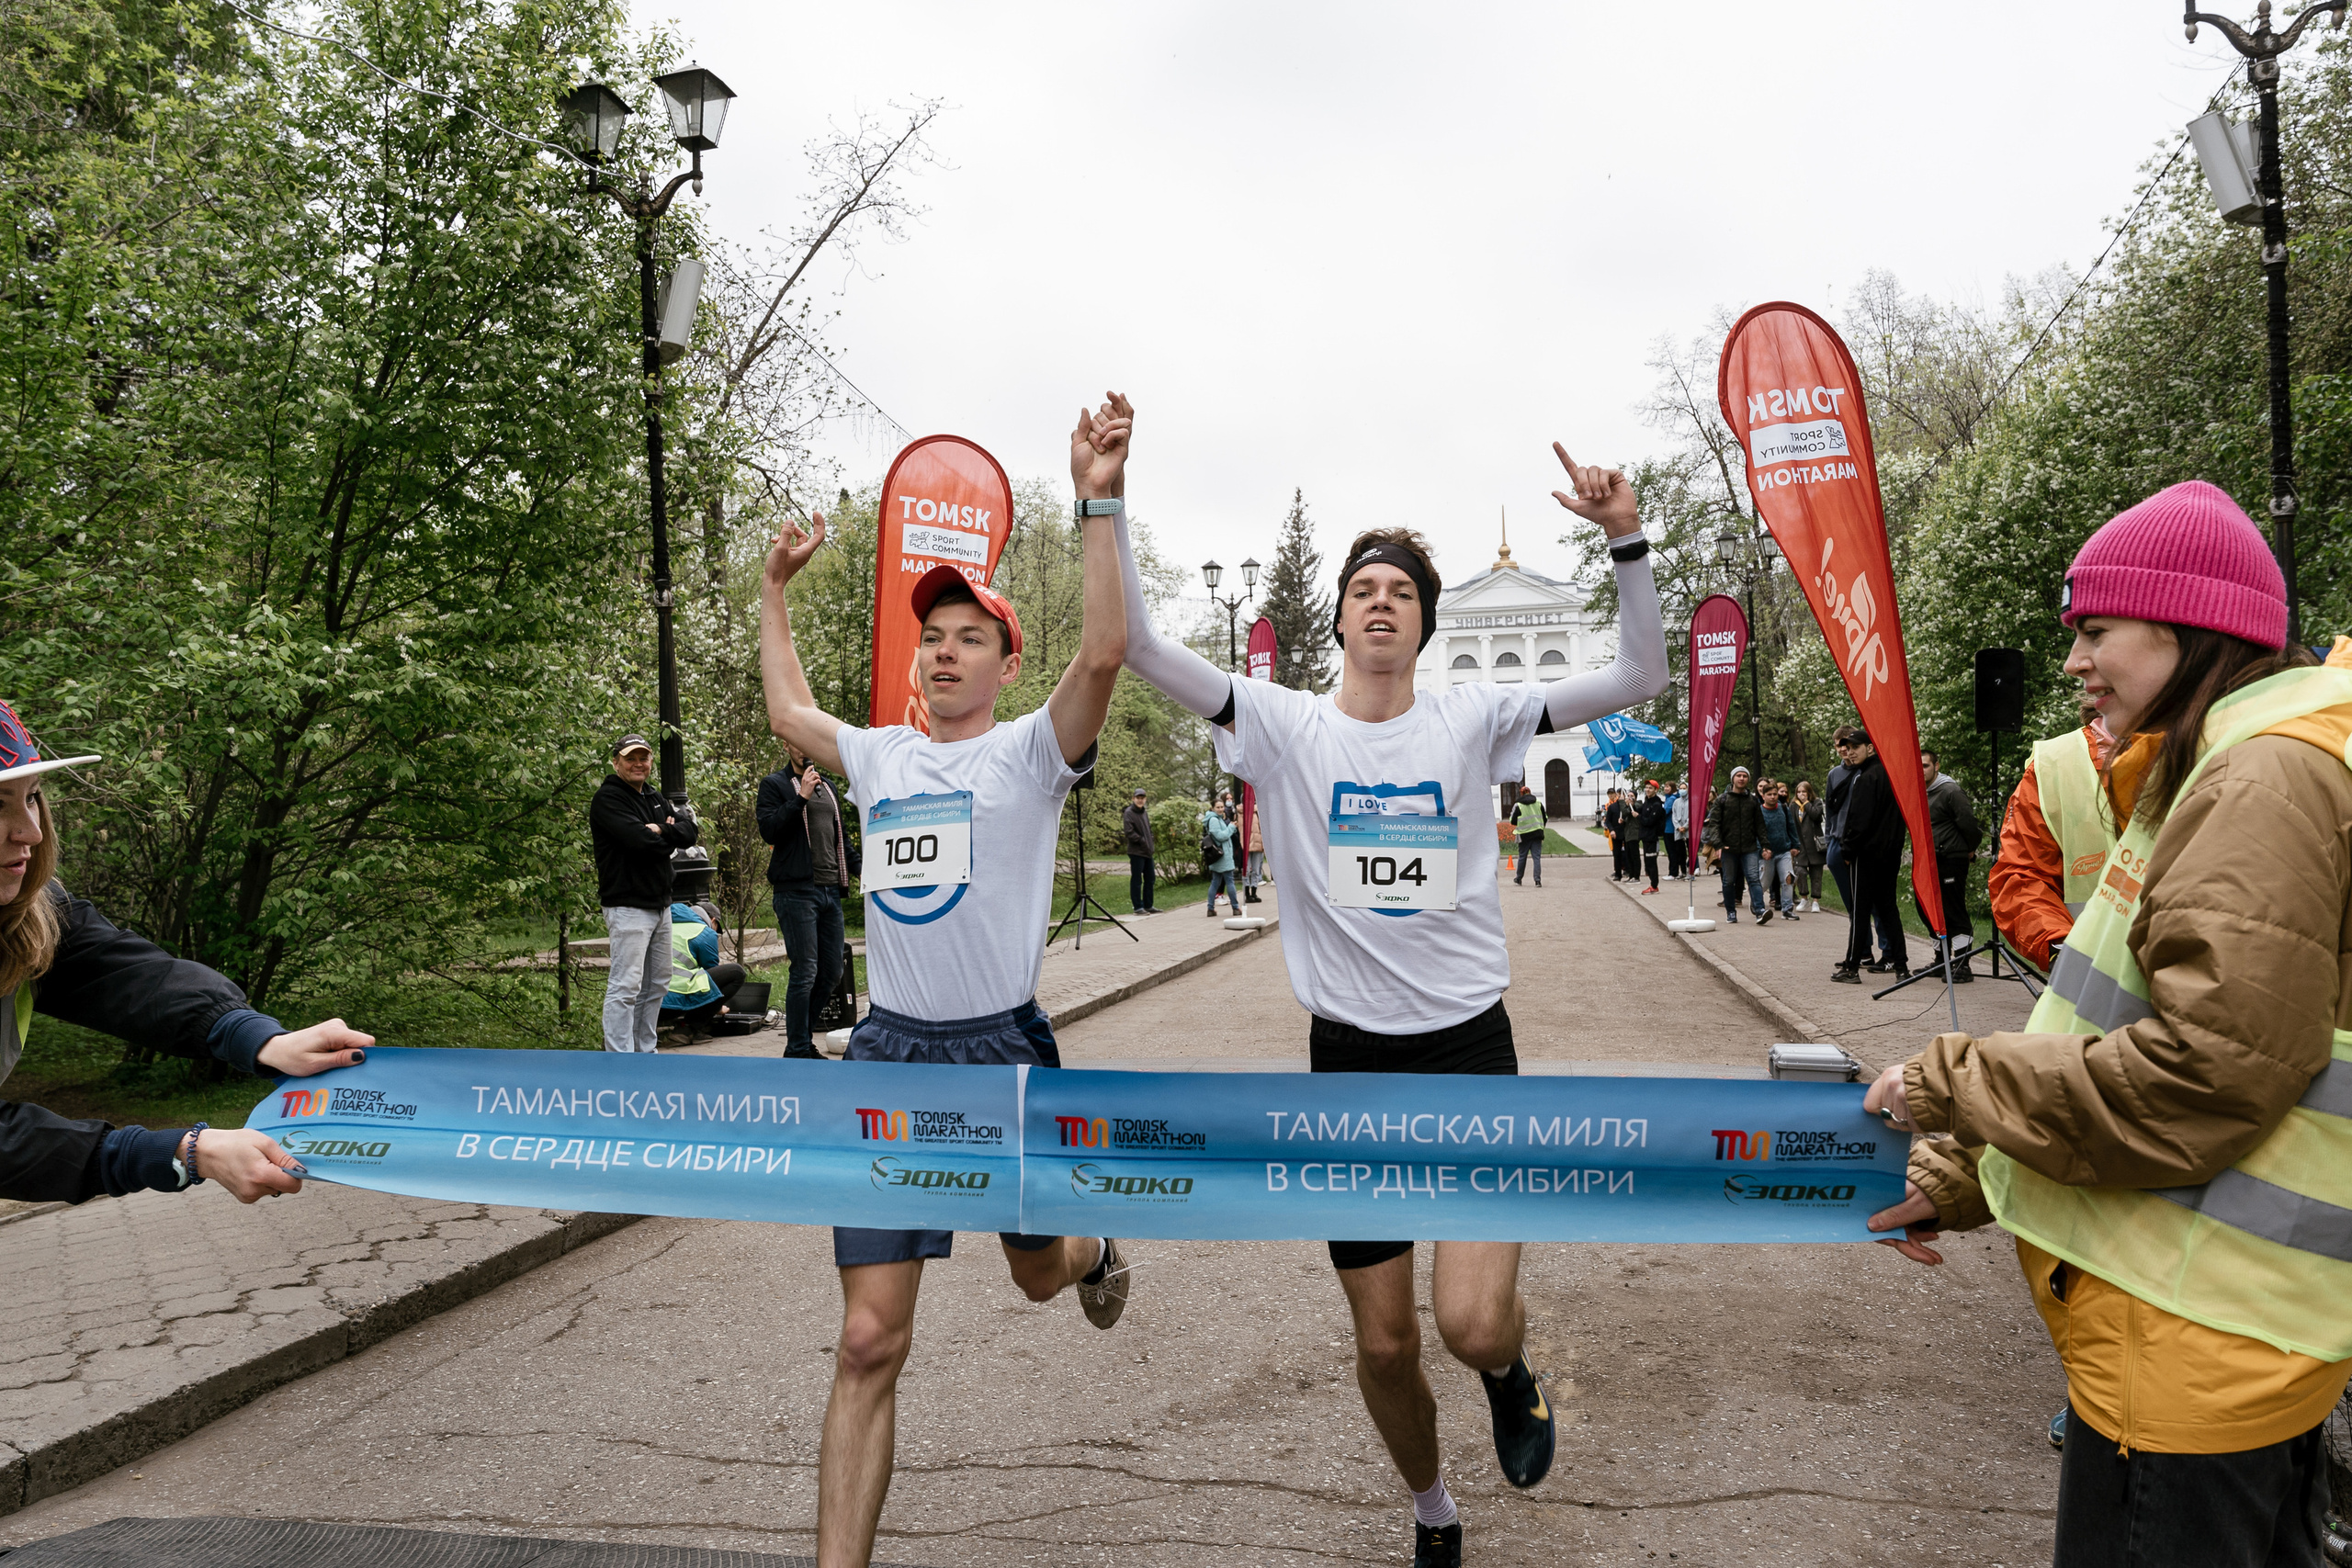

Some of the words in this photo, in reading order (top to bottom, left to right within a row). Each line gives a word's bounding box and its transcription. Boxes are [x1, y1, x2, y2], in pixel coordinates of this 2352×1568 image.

[899, 495, 991, 533] TOMSK
[932, 535, 960, 545] SPORT
[932, 544, 982, 558] COMMUNITY
[1455, 614, 1563, 629] УНИВЕРСИТЕТ
[1697, 630, 1736, 647] TOMSK
[1250, 651, 1271, 667] TOMSK
[1700, 665, 1736, 676] MARATHON
[902, 802, 941, 813] ТАМАНСКАЯ
[1349, 798, 1352, 807] I
[1358, 799, 1387, 811] LOVE
[906, 813, 932, 821] СЕРДЦЕ
[933, 810, 961, 818] СИБИРИ
[1380, 823, 1427, 831] ТАМАНСКАЯ
[1385, 834, 1417, 842] СЕРДЦЕ
[885, 834, 938, 866] 100
[1356, 856, 1428, 886] 104
[334, 1088, 386, 1102] TOMSK
[331, 1100, 417, 1116] MARATHON
[471, 1086, 685, 1120] ТАМАНСКАЯ
[696, 1093, 800, 1124] МИЛЯ
[910, 1111, 966, 1124] TOMSK
[913, 1124, 1002, 1139] MARATHON
[1113, 1118, 1169, 1133] TOMSK
[1266, 1111, 1514, 1145] ТАМАНСКАЯ
[1528, 1116, 1648, 1148] МИЛЯ
[1114, 1131, 1205, 1145] MARATHON
[1775, 1131, 1838, 1144] TOMSK
[292, 1140, 391, 1157] ЭФКО
[455, 1134, 481, 1158] В
[488, 1135, 635, 1172] СЕРДЦЕ
[642, 1143, 792, 1175] СИБИРИ
[1775, 1142, 1876, 1156] MARATHON
[888, 1168, 990, 1189] ЭФКО
[1090, 1176, 1193, 1195] ЭФКО
[1266, 1162, 1289, 1191] В
[1300, 1163, 1459, 1200] СЕРДЦЕ
[1470, 1167, 1634, 1194] СИБИРИ
[1744, 1185, 1857, 1201] ЭФКО
